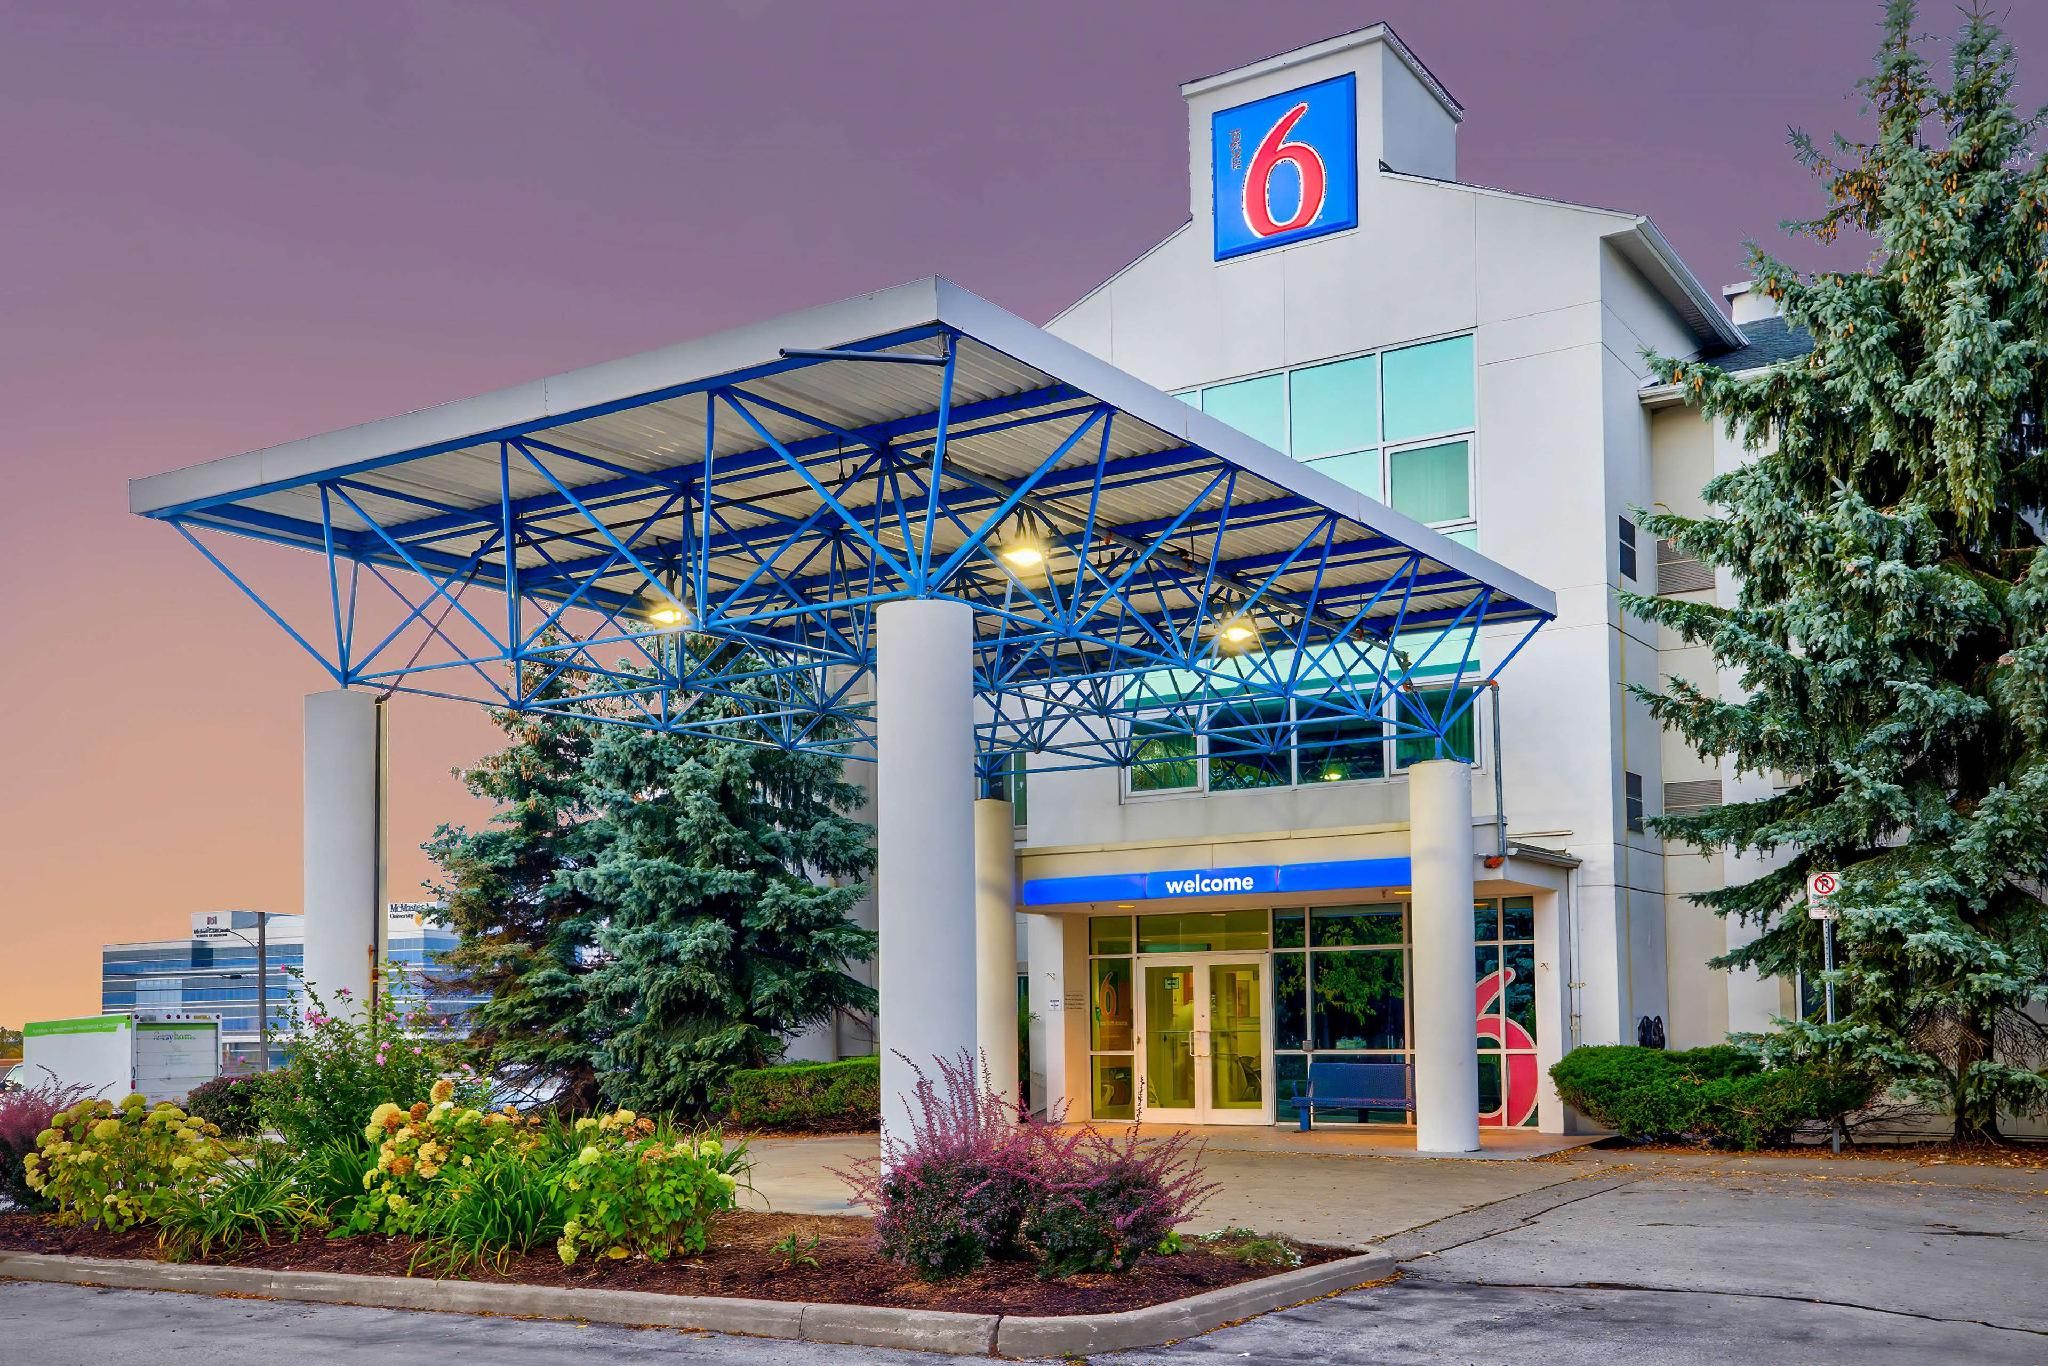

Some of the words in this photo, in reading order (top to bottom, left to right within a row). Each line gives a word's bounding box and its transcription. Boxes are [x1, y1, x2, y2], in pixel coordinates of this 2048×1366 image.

[1242, 101, 1328, 239] 6
[1165, 873, 1254, 894] welcome
[1099, 971, 1117, 1018] 6
